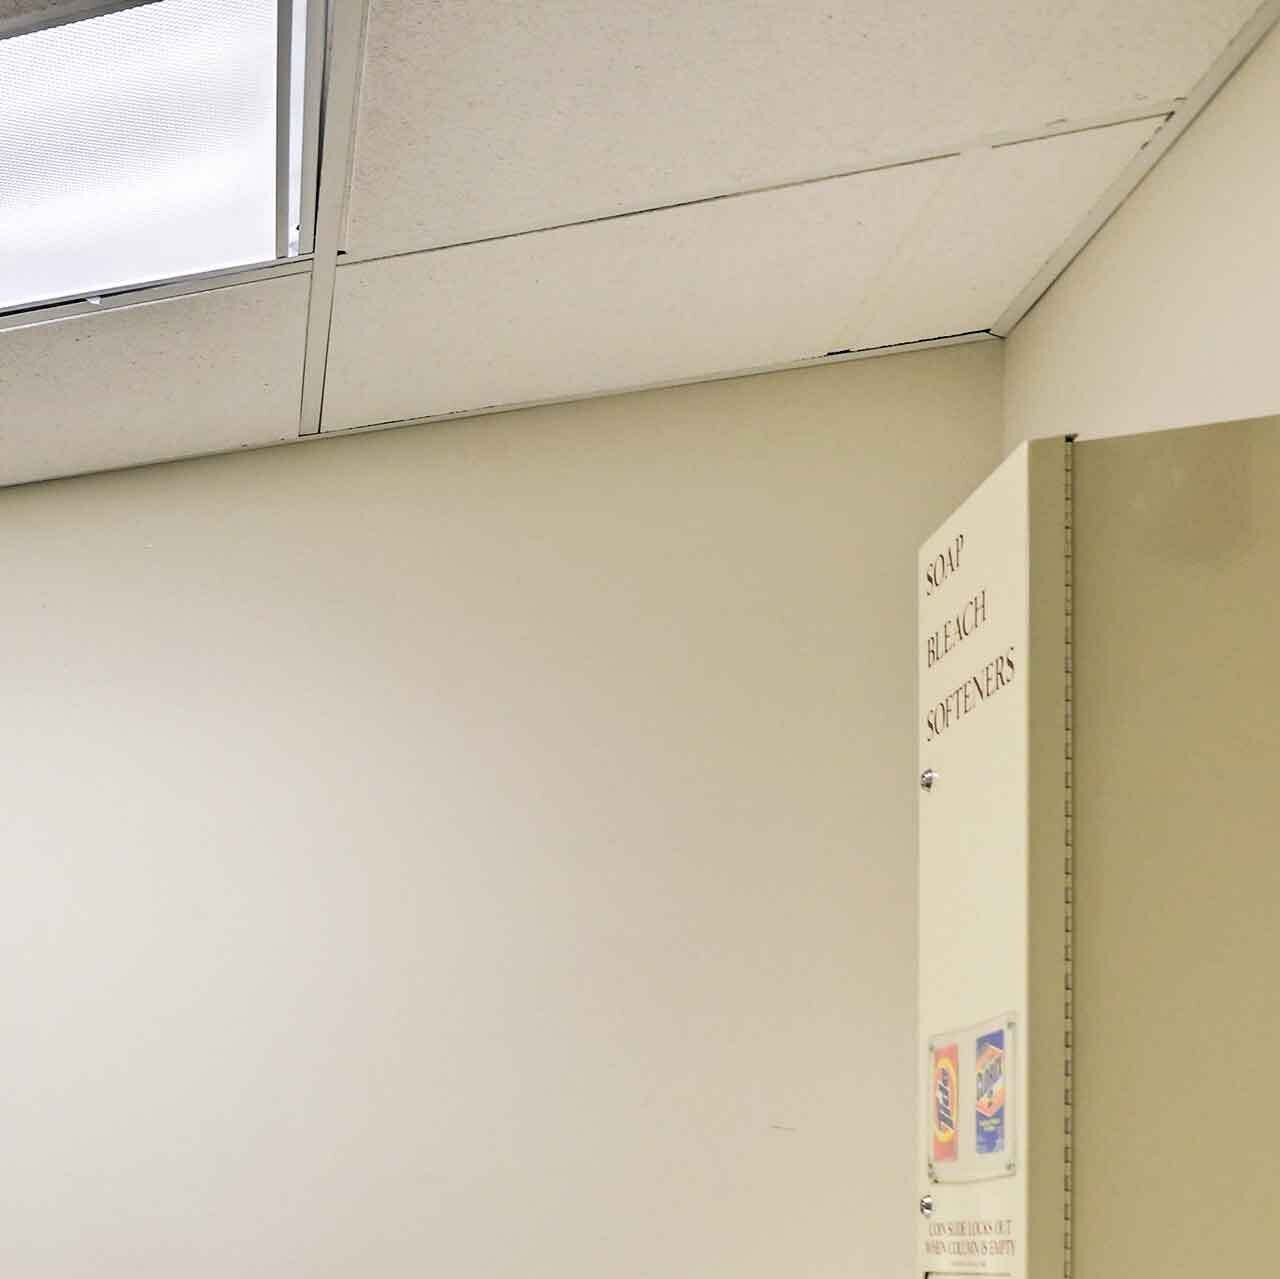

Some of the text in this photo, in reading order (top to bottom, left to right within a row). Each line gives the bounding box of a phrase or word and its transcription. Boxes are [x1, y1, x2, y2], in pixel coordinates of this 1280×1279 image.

[927, 534, 964, 596] SOAP
[928, 590, 987, 668] BLEACH
[927, 647, 1015, 741] SOFTENERS
